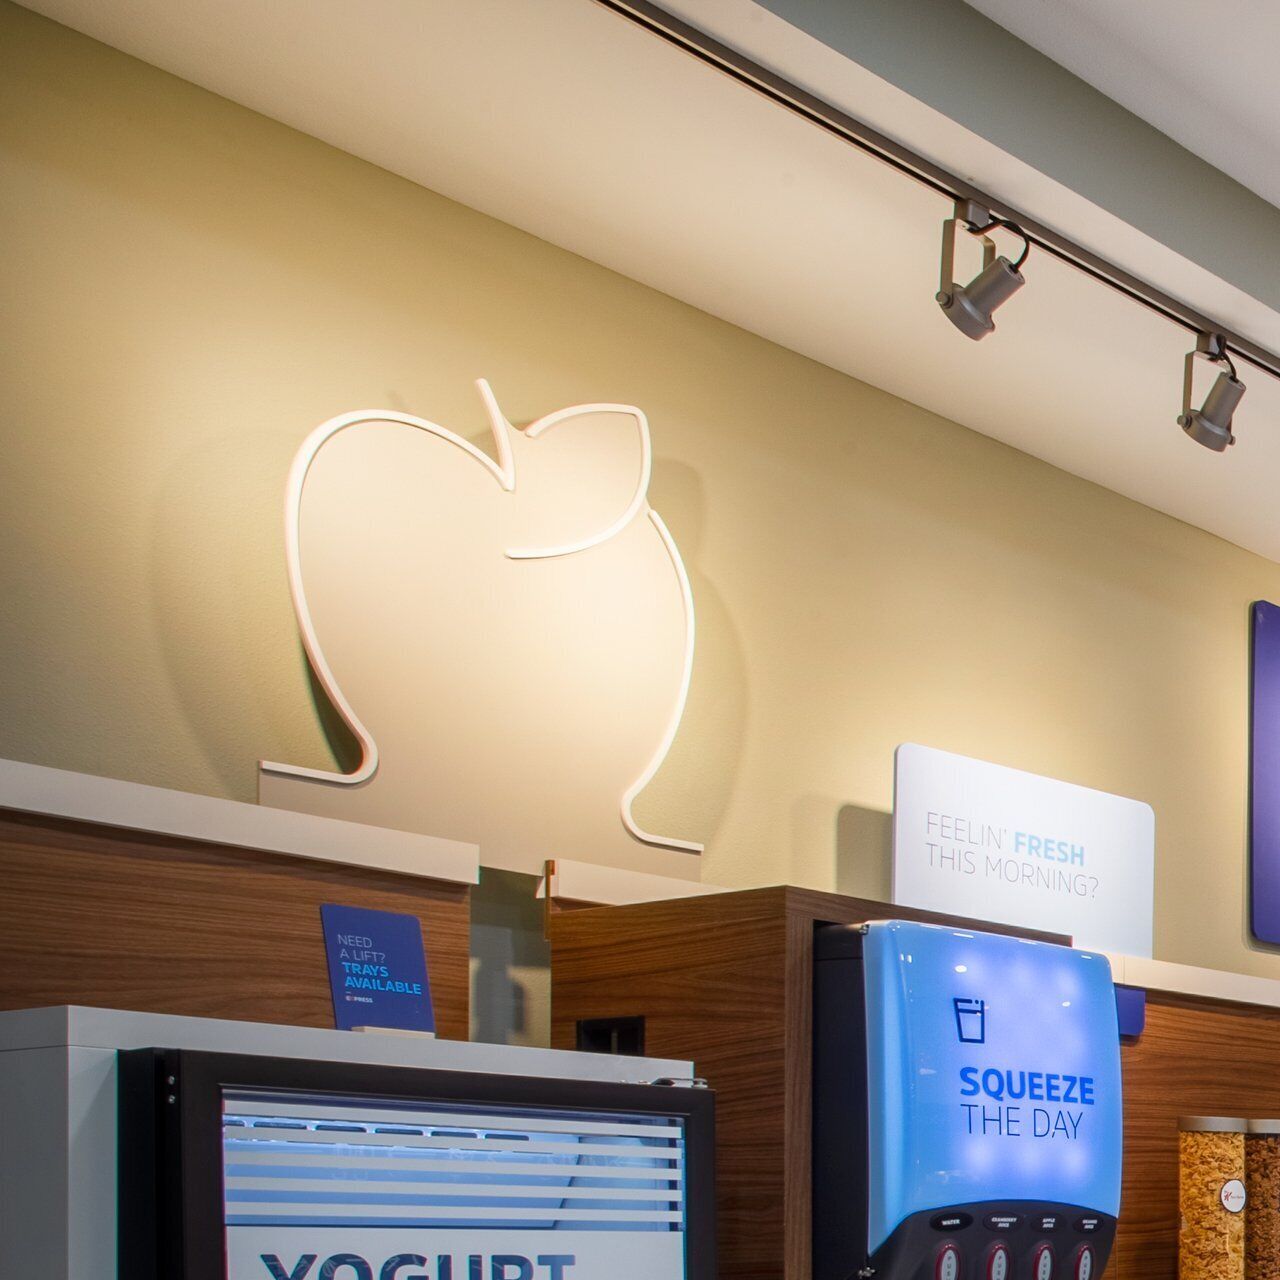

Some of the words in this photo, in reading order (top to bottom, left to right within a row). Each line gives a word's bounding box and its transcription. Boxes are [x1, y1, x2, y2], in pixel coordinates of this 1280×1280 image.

[1014, 831, 1085, 866] FRESH
[925, 842, 976, 875] THIS
[985, 855, 1099, 899] MORNING?
[337, 934, 372, 948] NEED
[340, 948, 350, 959] A
[353, 950, 386, 963] LIFT?
[342, 962, 389, 977] TRAYS
[345, 976, 422, 995] AVAILABLE
[959, 1066, 1095, 1105] SQUEEZE
[960, 1104, 1020, 1136] THE
[1033, 1108, 1083, 1139] DAY
